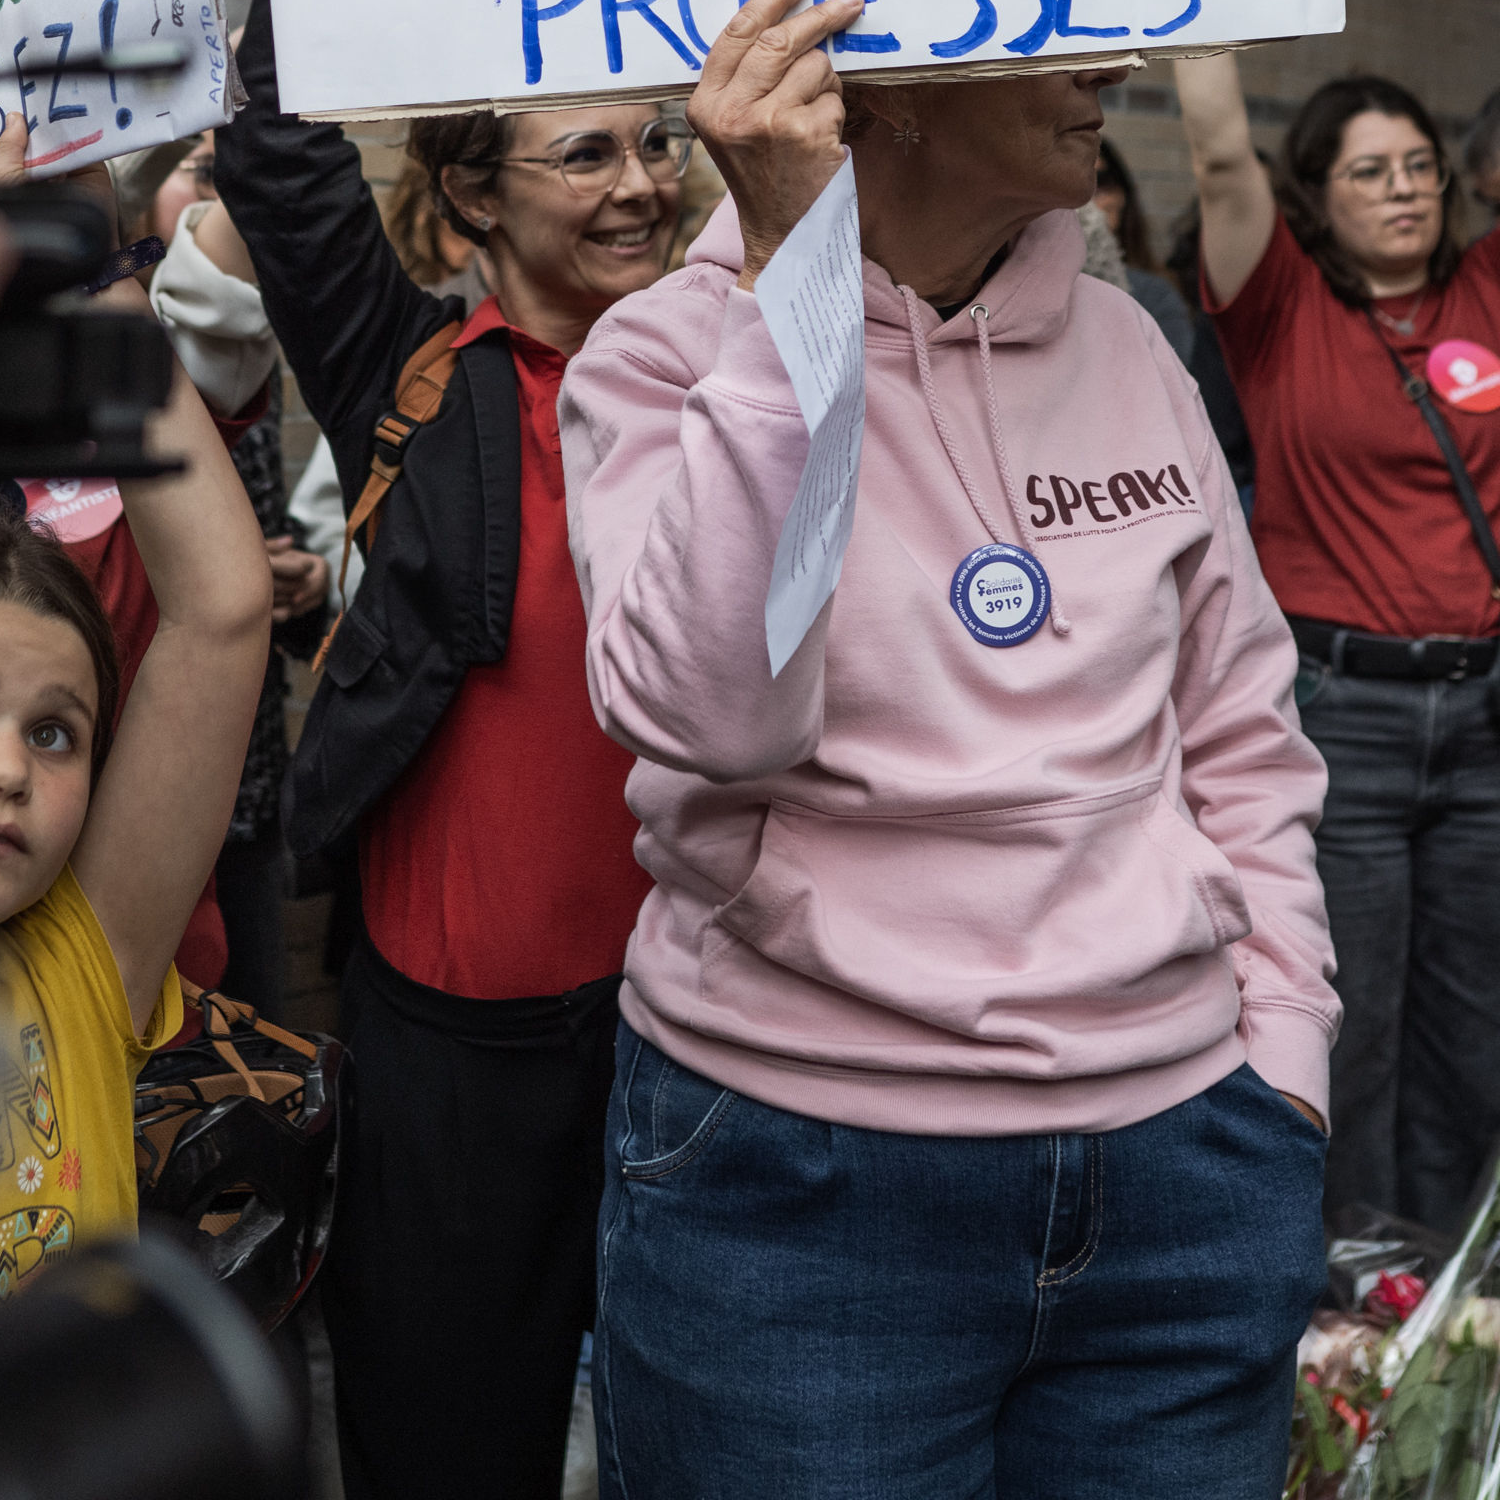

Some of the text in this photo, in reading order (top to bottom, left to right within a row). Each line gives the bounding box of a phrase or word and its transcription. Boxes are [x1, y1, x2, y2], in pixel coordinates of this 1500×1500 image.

[199, 4, 225, 105] APERTO
[1025, 463, 1197, 529] SPEAK!
[985, 575, 1022, 588] Solidarité
[985, 596, 1023, 614] 3919
